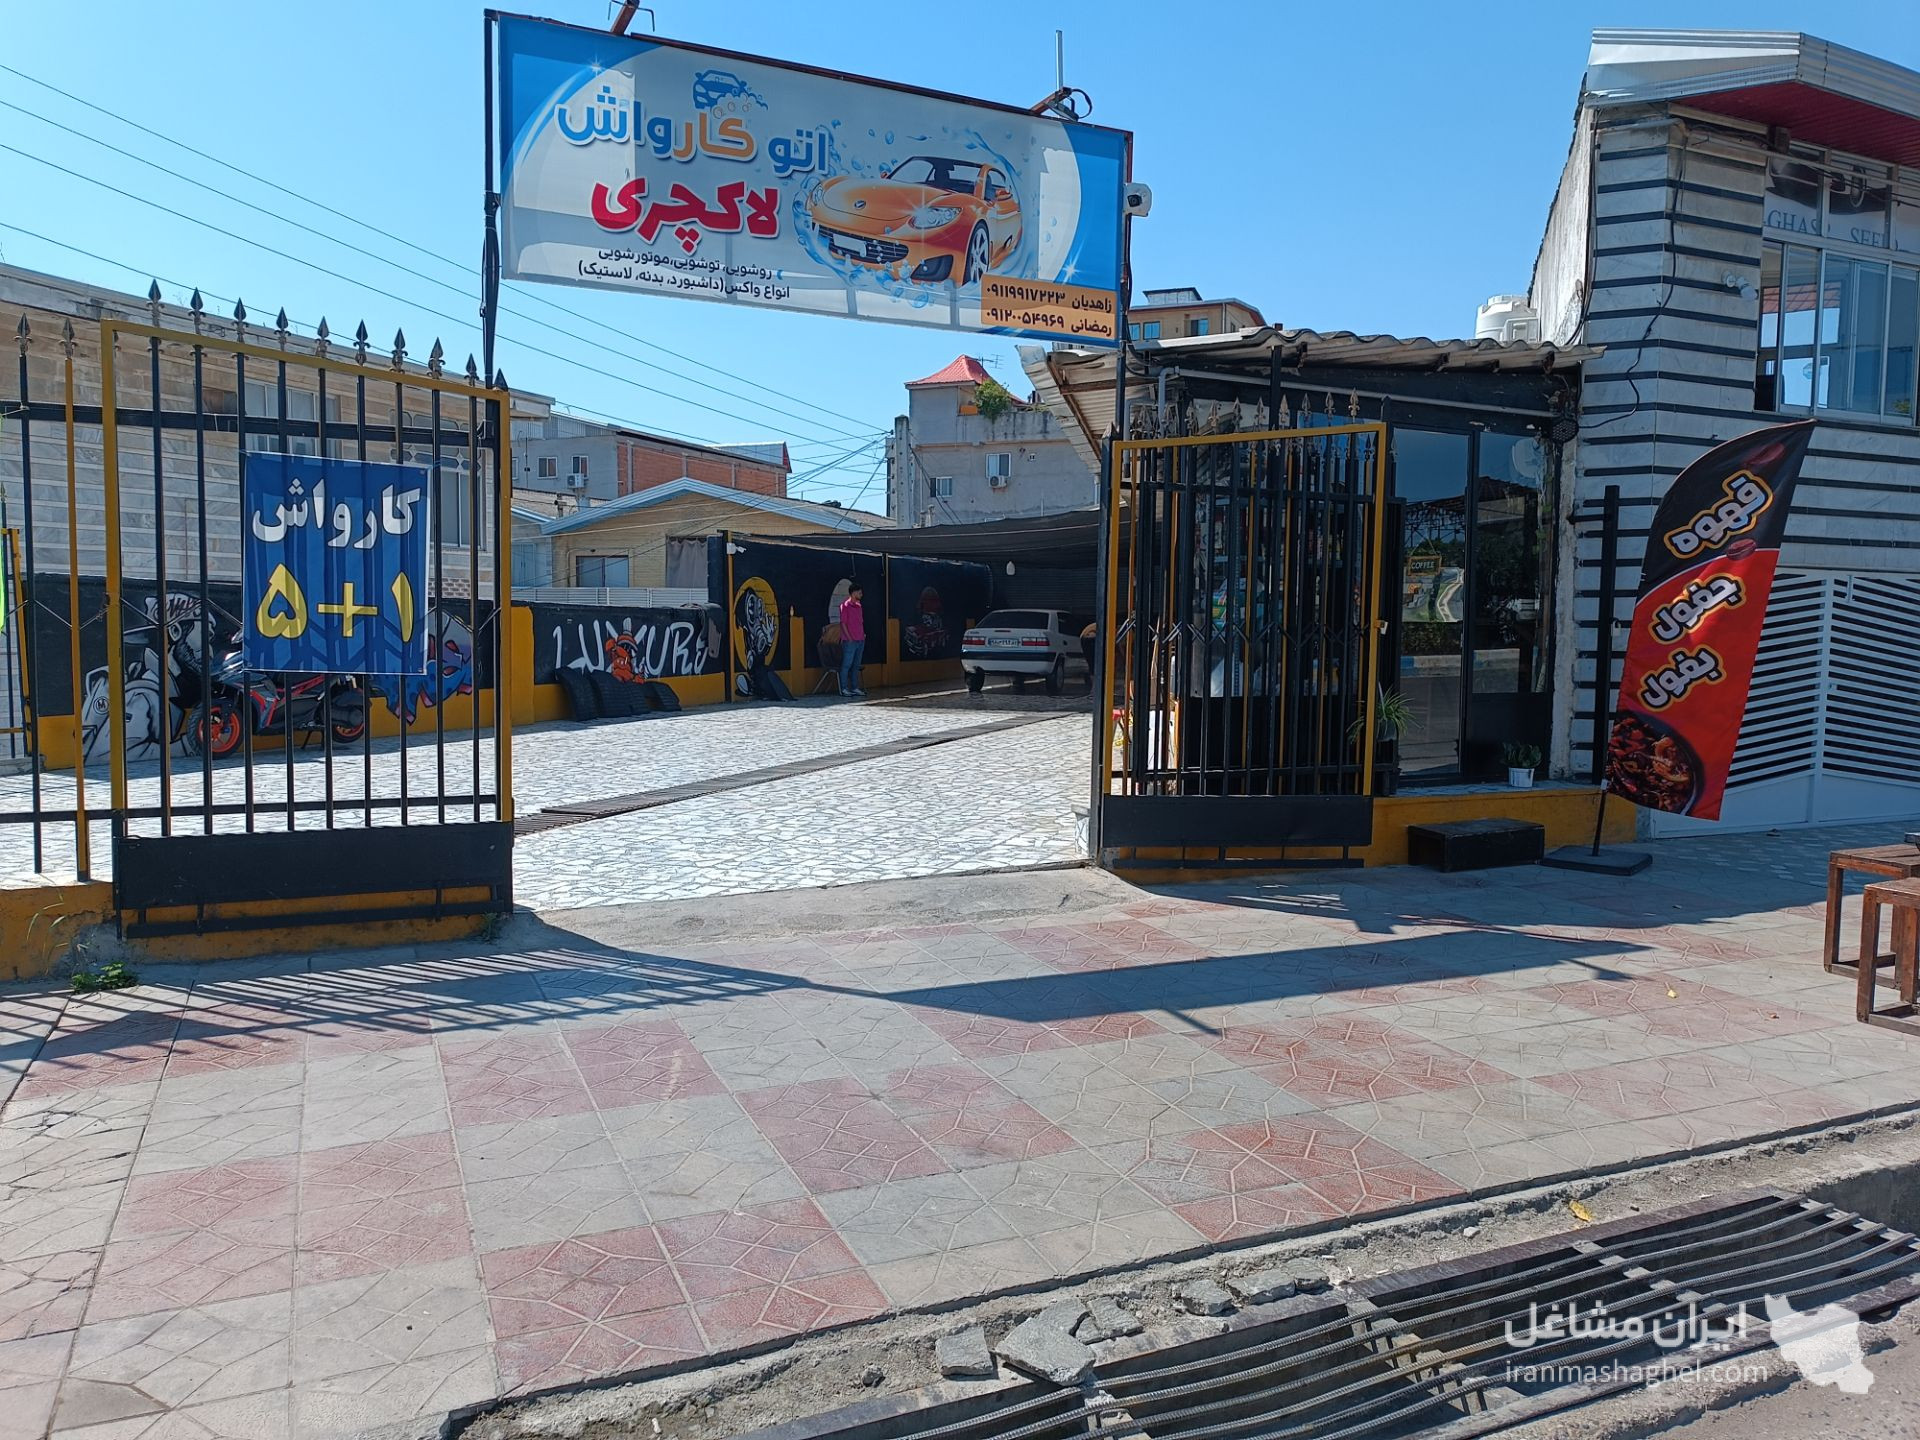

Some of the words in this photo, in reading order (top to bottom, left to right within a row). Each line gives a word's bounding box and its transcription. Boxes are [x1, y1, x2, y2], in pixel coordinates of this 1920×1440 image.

[555, 84, 758, 160] کارواش
[768, 127, 827, 175] اتو
[591, 177, 779, 253] لاکچری
[764, 284, 791, 300] انواع
[1071, 294, 1112, 314] زاهدیان
[1070, 318, 1112, 337] رمضانی
[252, 477, 422, 549] کارواش
[1671, 476, 1767, 554] قهوه
[1643, 650, 1718, 707] بغول
